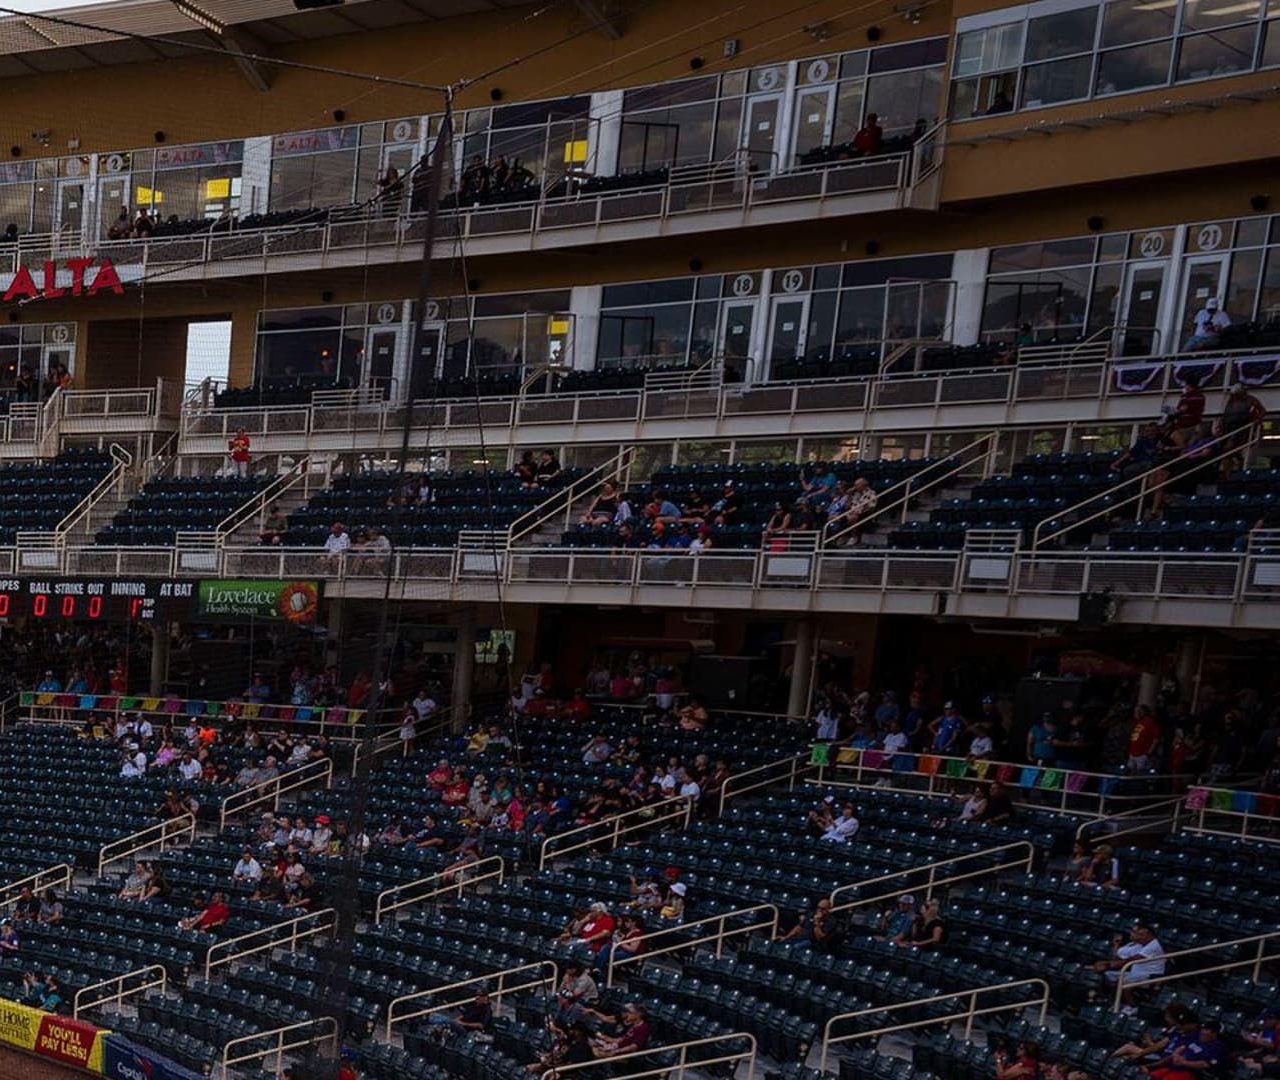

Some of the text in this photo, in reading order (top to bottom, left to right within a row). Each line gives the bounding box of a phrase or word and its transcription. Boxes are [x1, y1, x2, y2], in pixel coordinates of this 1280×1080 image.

[813, 65, 822, 78] 6
[763, 72, 772, 86] 5
[398, 126, 406, 138] 3
[111, 158, 118, 170] 2
[1144, 237, 1162, 253] 20
[1201, 230, 1218, 246] 21
[4, 257, 124, 301] ALTA
[736, 278, 751, 292] 18
[785, 274, 801, 288] 19
[380, 308, 393, 320] 16
[30, 582, 51, 594] BALL
[55, 583, 83, 595] STRIKE
[88, 583, 104, 595] OUT
[111, 582, 145, 595] INNING
[160, 583, 173, 596] AT
[174, 583, 193, 596] BAT
[208, 586, 275, 604] Lovelace
[33, 594, 47, 616] 0
[62, 595, 75, 616] 0
[89, 596, 102, 618] 0
[206, 604, 228, 613] Health
[3, 1009, 31, 1028] HOME
[48, 1023, 82, 1045] YOU'LL
[41, 1034, 87, 1060] PAY LESS!
